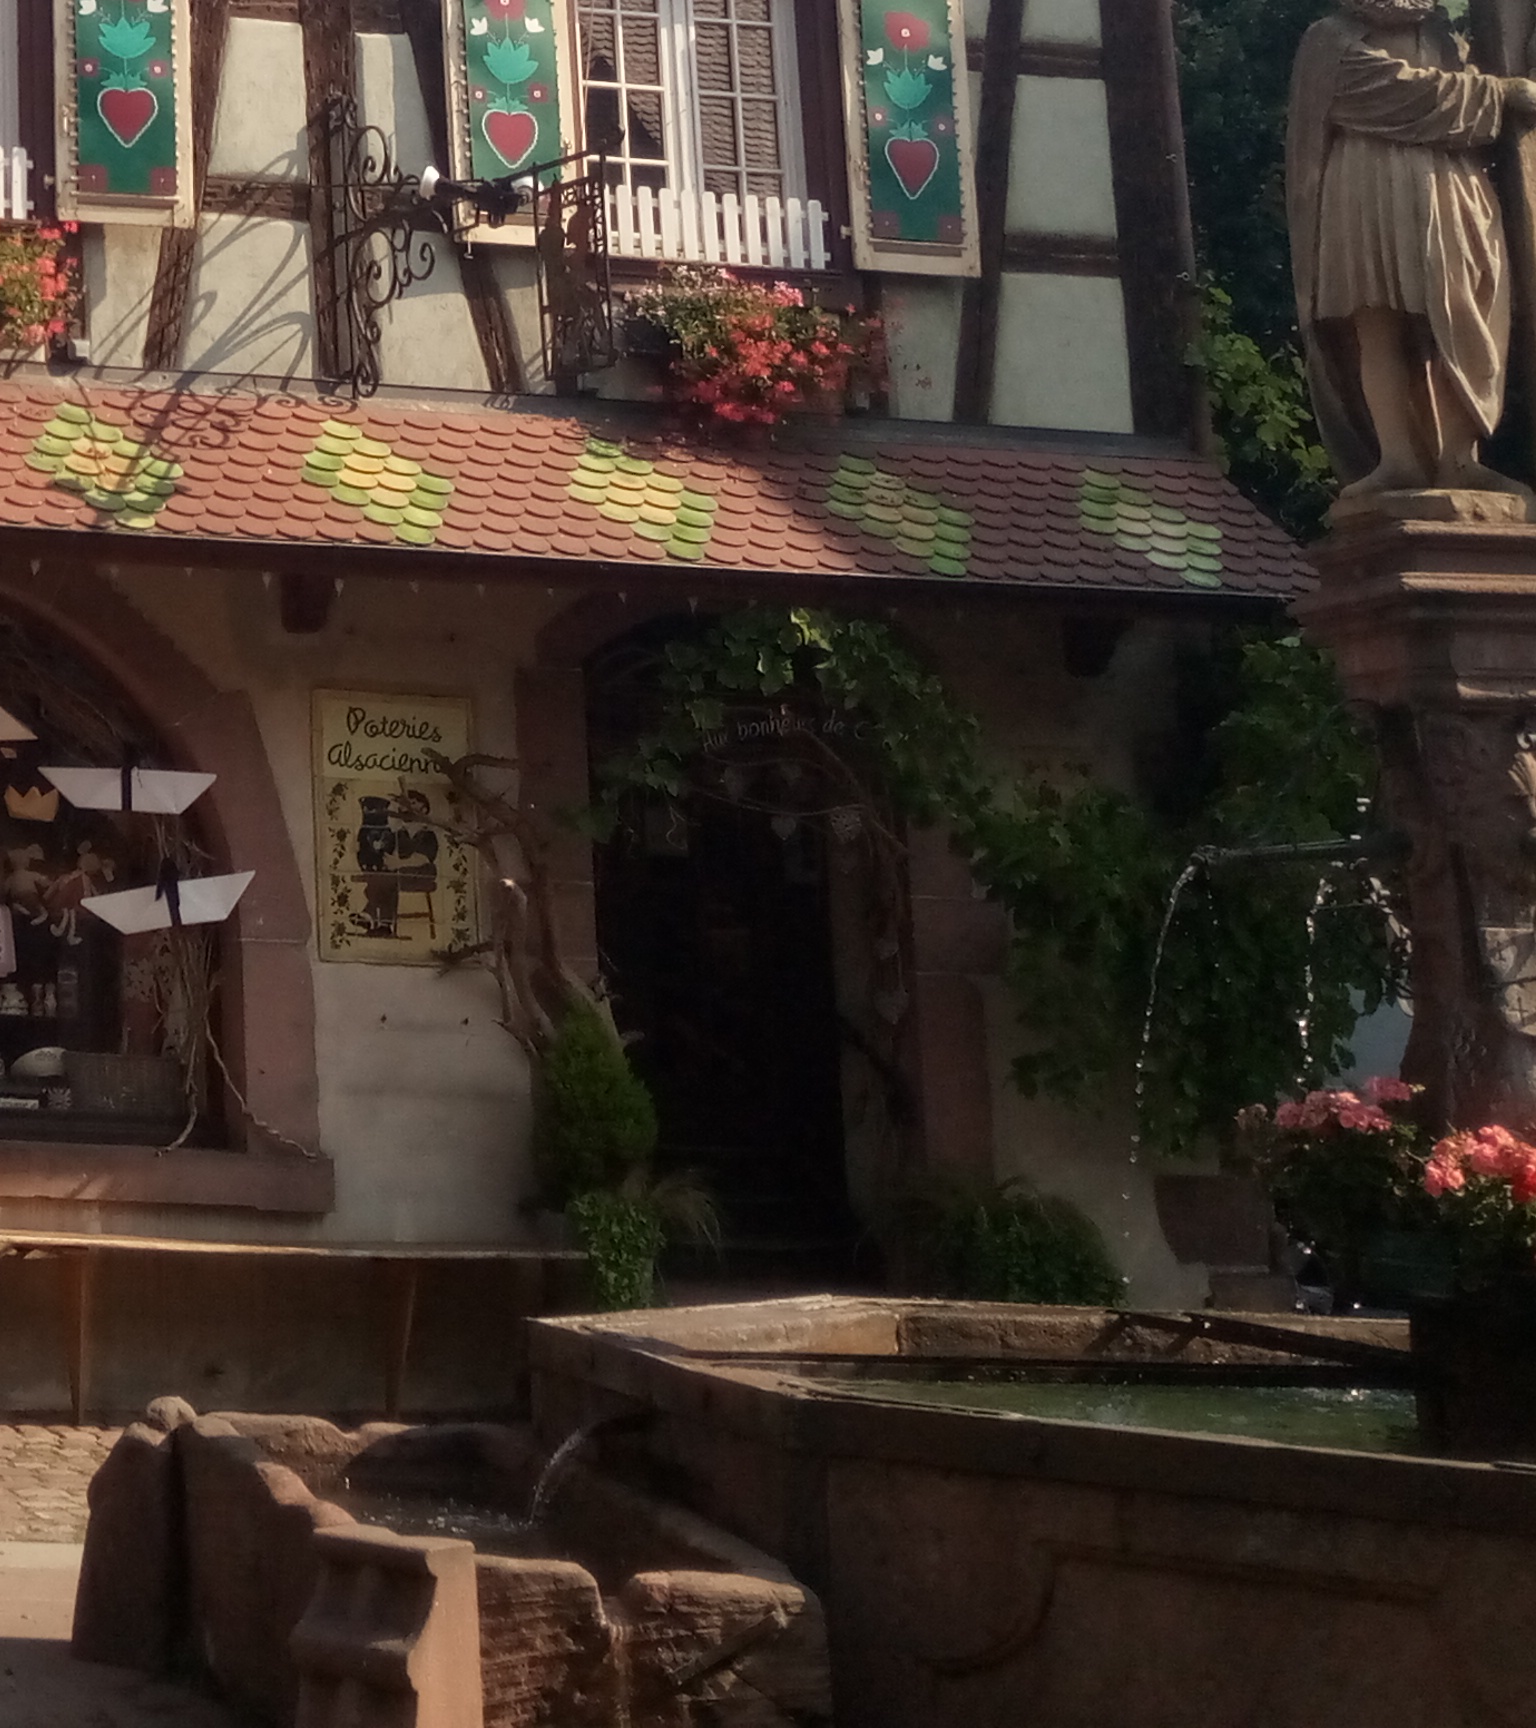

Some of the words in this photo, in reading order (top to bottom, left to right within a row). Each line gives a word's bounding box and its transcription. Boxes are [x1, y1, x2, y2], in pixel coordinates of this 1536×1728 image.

[346, 706, 443, 743] Poteries
[823, 708, 845, 736] de
[328, 740, 444, 775] Alsacienn
